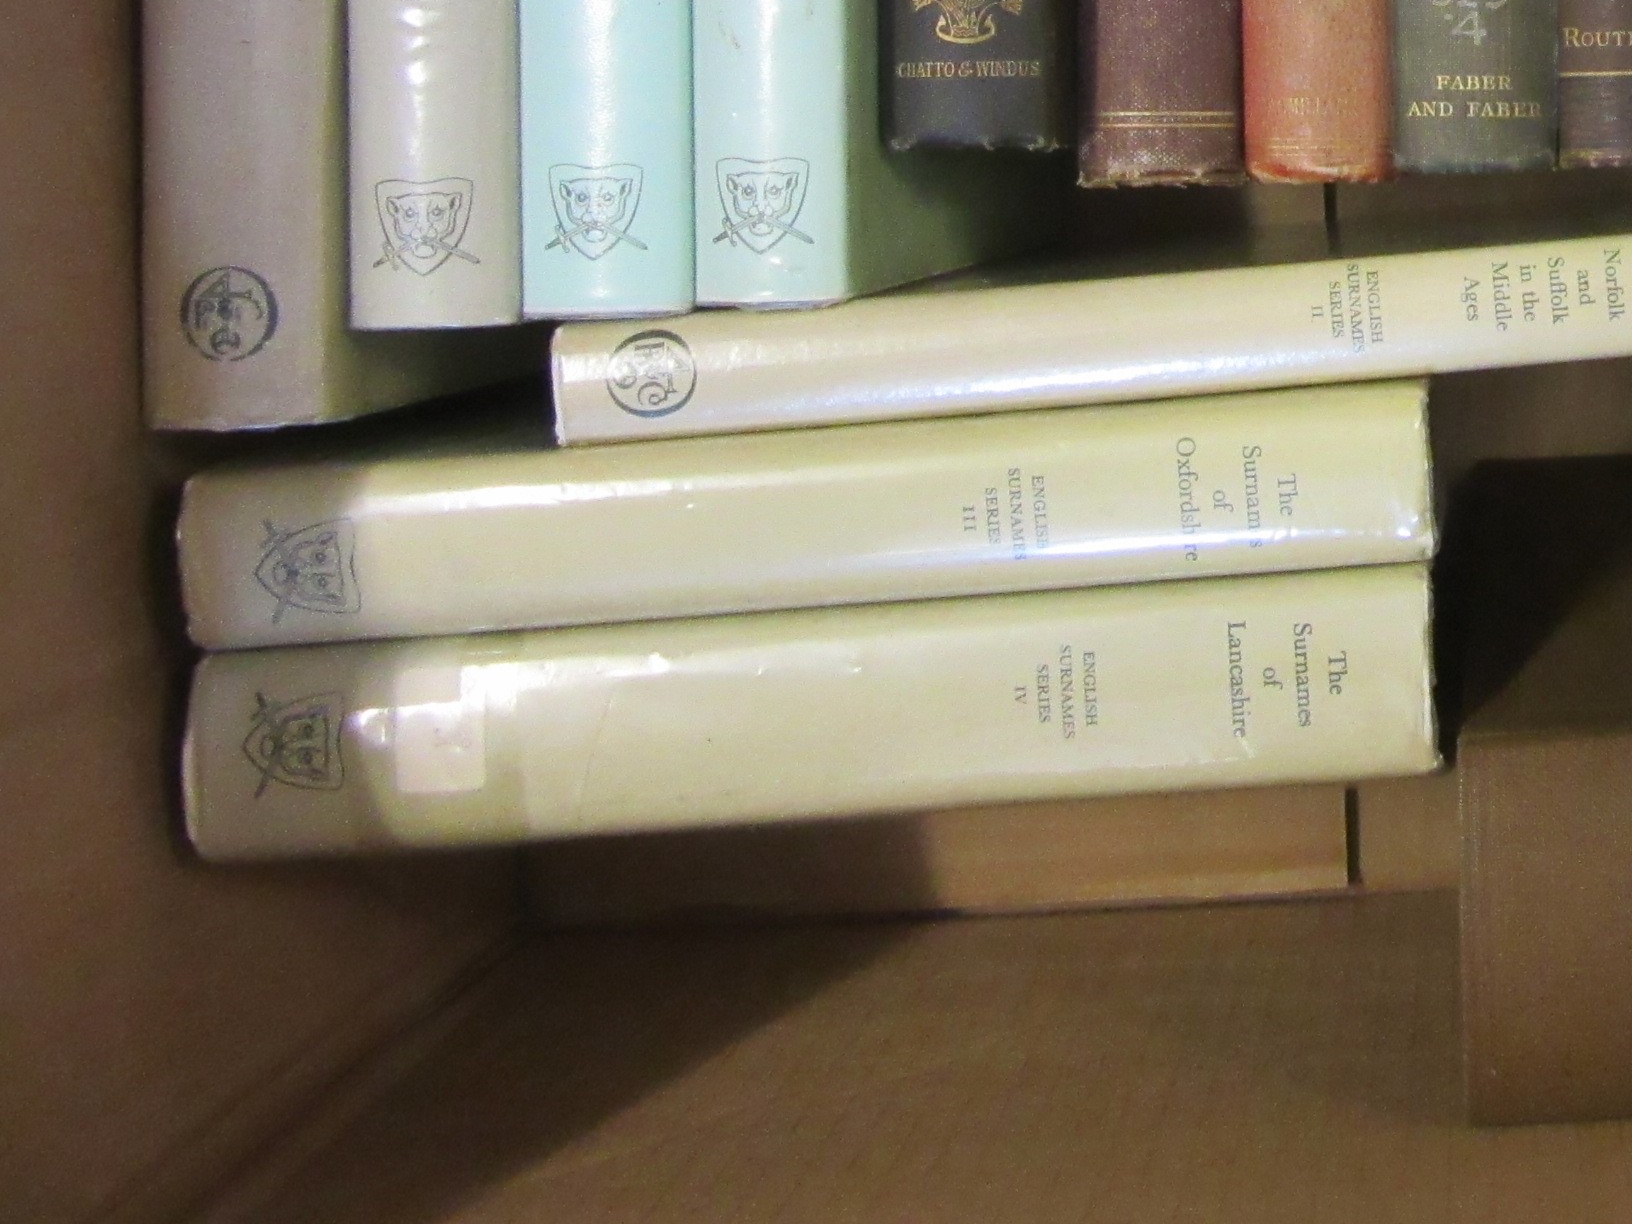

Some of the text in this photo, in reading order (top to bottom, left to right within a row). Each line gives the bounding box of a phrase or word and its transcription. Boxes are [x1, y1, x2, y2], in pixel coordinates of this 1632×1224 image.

[976, 59, 1041, 79] WINDUS
[1436, 73, 1514, 92] FABER
[1408, 99, 1542, 119] AND FABER
[1328, 281, 1345, 339] SERIES
[1346, 263, 1366, 355] SURNAMES
[1366, 270, 1384, 345] ENGLISH
[1460, 276, 1481, 323] Ages
[1491, 261, 1514, 332] Middle
[1519, 264, 1540, 323] in the
[1547, 256, 1570, 325] Suffolk
[1576, 269, 1597, 307] and
[1603, 248, 1626, 322] Norfolk
[962, 505, 977, 533] III
[985, 487, 1001, 546] SERIES
[1007, 467, 1028, 561] SURNAMES
[1031, 474, 1052, 550] ENGLISH
[1176, 436, 1203, 562] Oxfordshre
[1212, 489, 1235, 514] of
[1242, 444, 1264, 549] Surnams
[1277, 473, 1299, 517] The
[1013, 684, 1027, 705] IV
[1036, 663, 1052, 724] SERIES
[1059, 643, 1076, 740] SURNAMES
[1083, 650, 1099, 727] ENGLISH
[1228, 620, 1251, 739] Lancashire
[1263, 666, 1284, 691] of
[1293, 622, 1314, 728] Surnames
[1328, 649, 1348, 696] The
